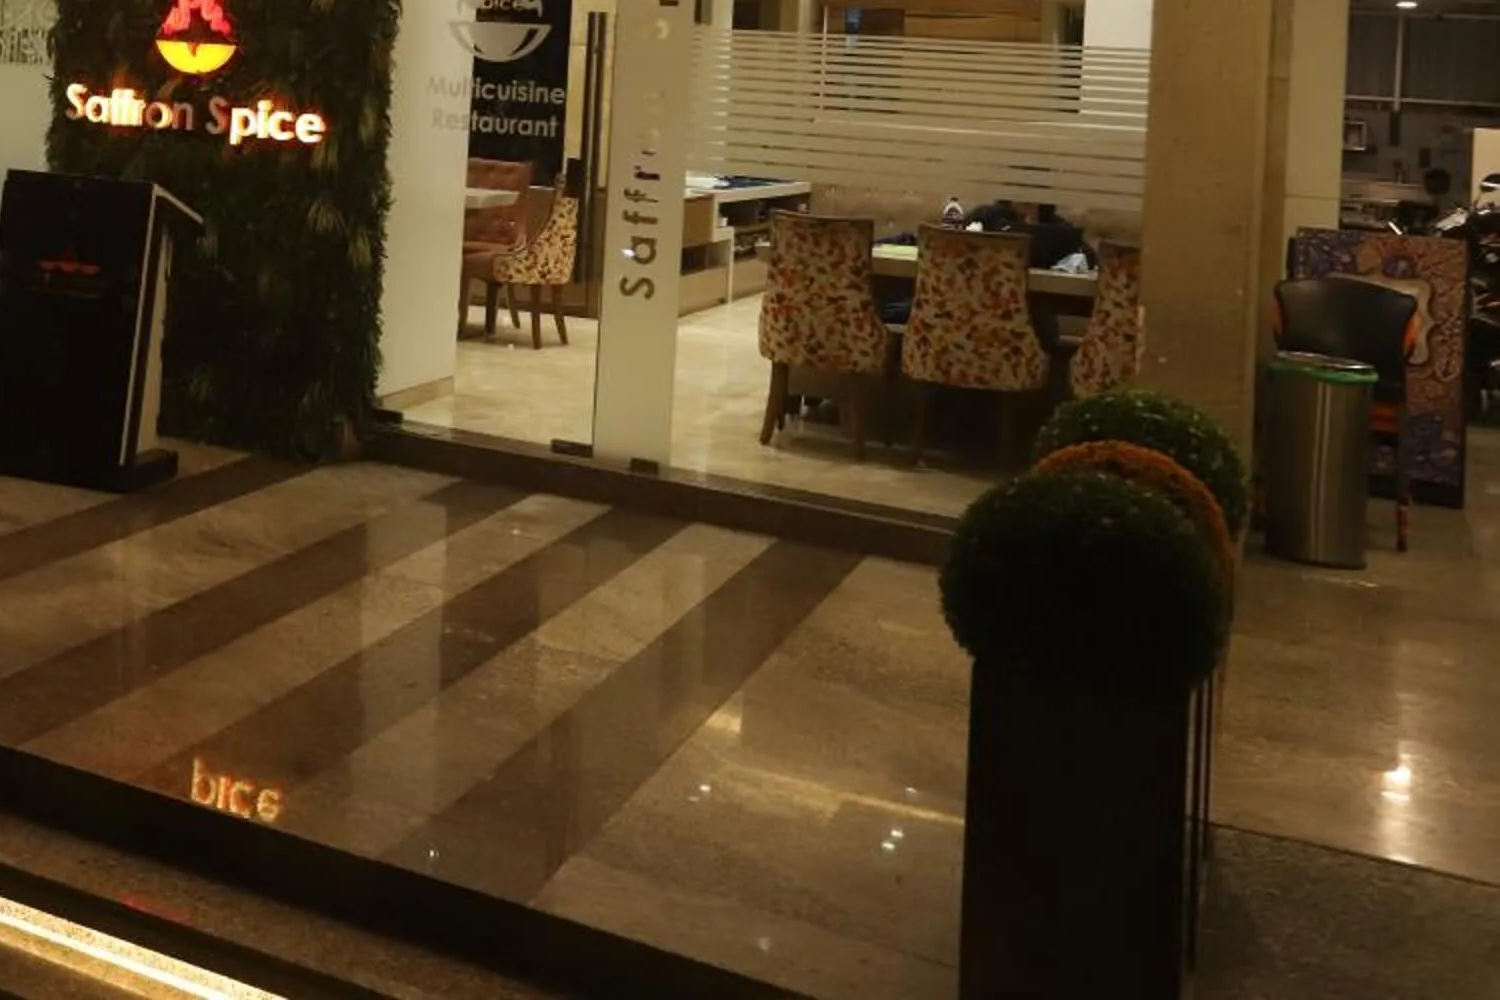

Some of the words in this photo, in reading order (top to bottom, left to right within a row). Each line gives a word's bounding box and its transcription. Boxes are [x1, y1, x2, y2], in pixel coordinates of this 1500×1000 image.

[66, 83, 193, 131] Saffron
[205, 96, 326, 145] Spice
[619, 88, 662, 300] Saffr
